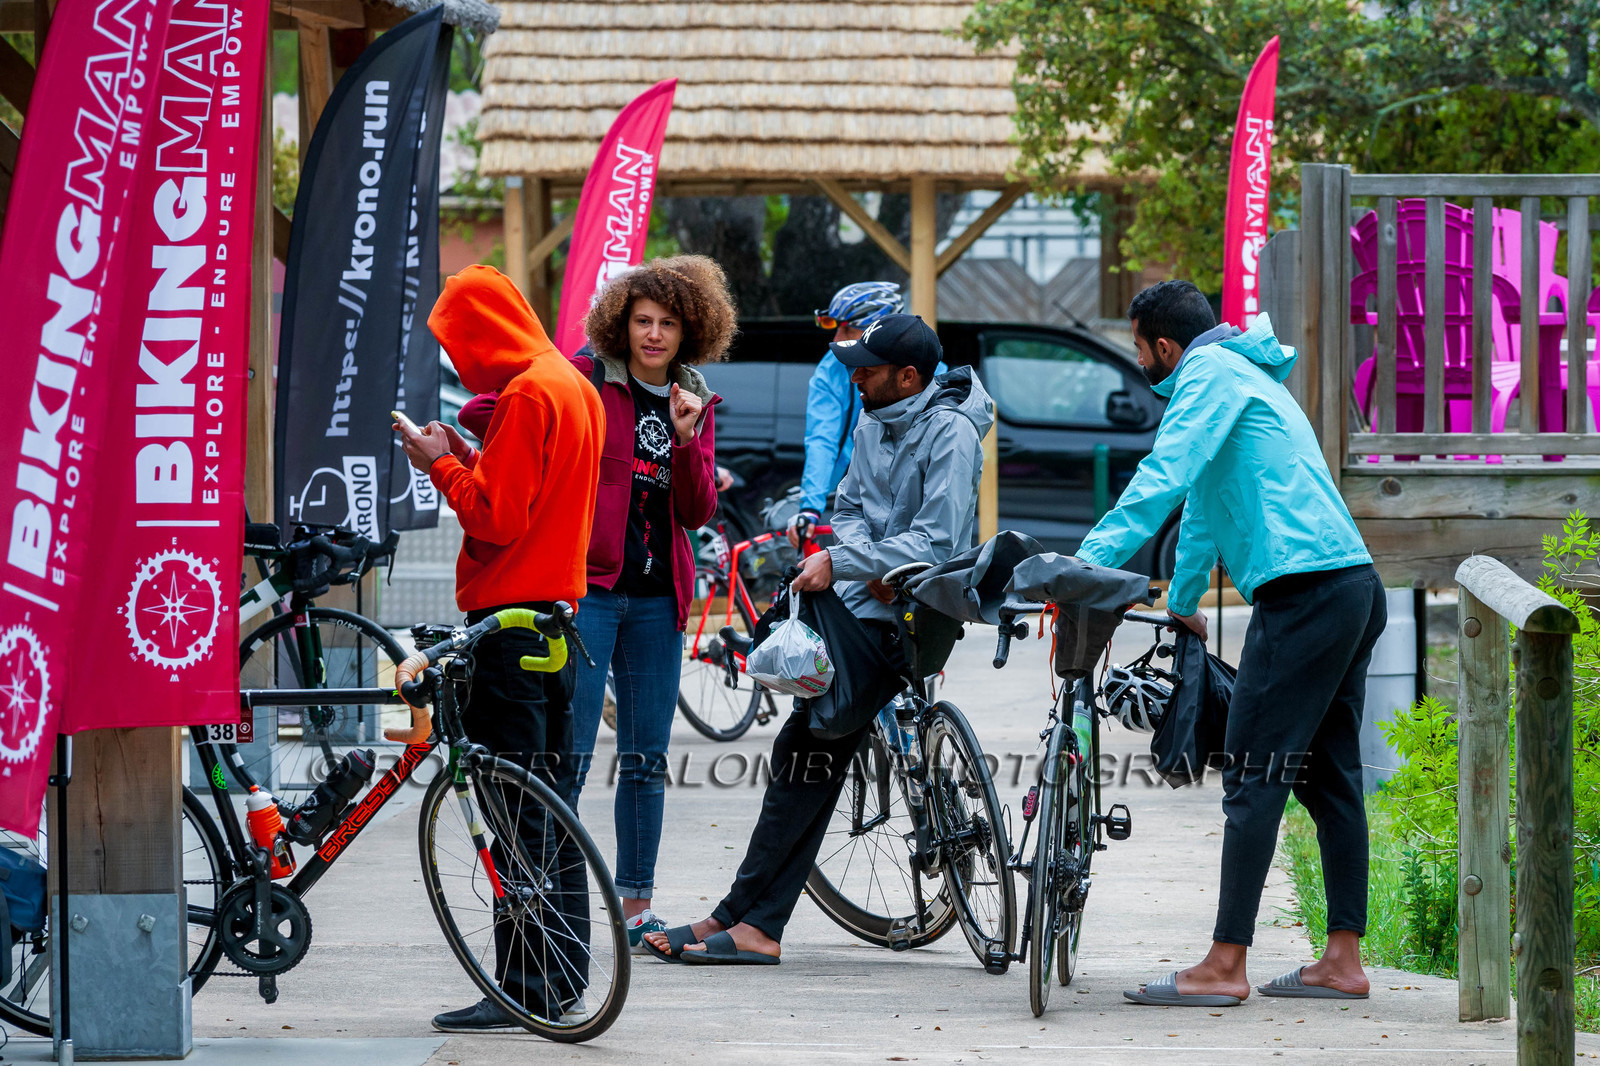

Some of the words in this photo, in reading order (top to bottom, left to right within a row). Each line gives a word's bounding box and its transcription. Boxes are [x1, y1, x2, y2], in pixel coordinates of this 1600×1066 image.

[211, 172, 236, 308] ENDURE
[325, 80, 390, 437] https://krono.run
[202, 352, 225, 504] EXPLORE
[52, 414, 85, 587] EXPLORE
[351, 463, 373, 540] KRONO
[643, 557, 653, 575] ULTRA
[210, 724, 234, 741] 38
